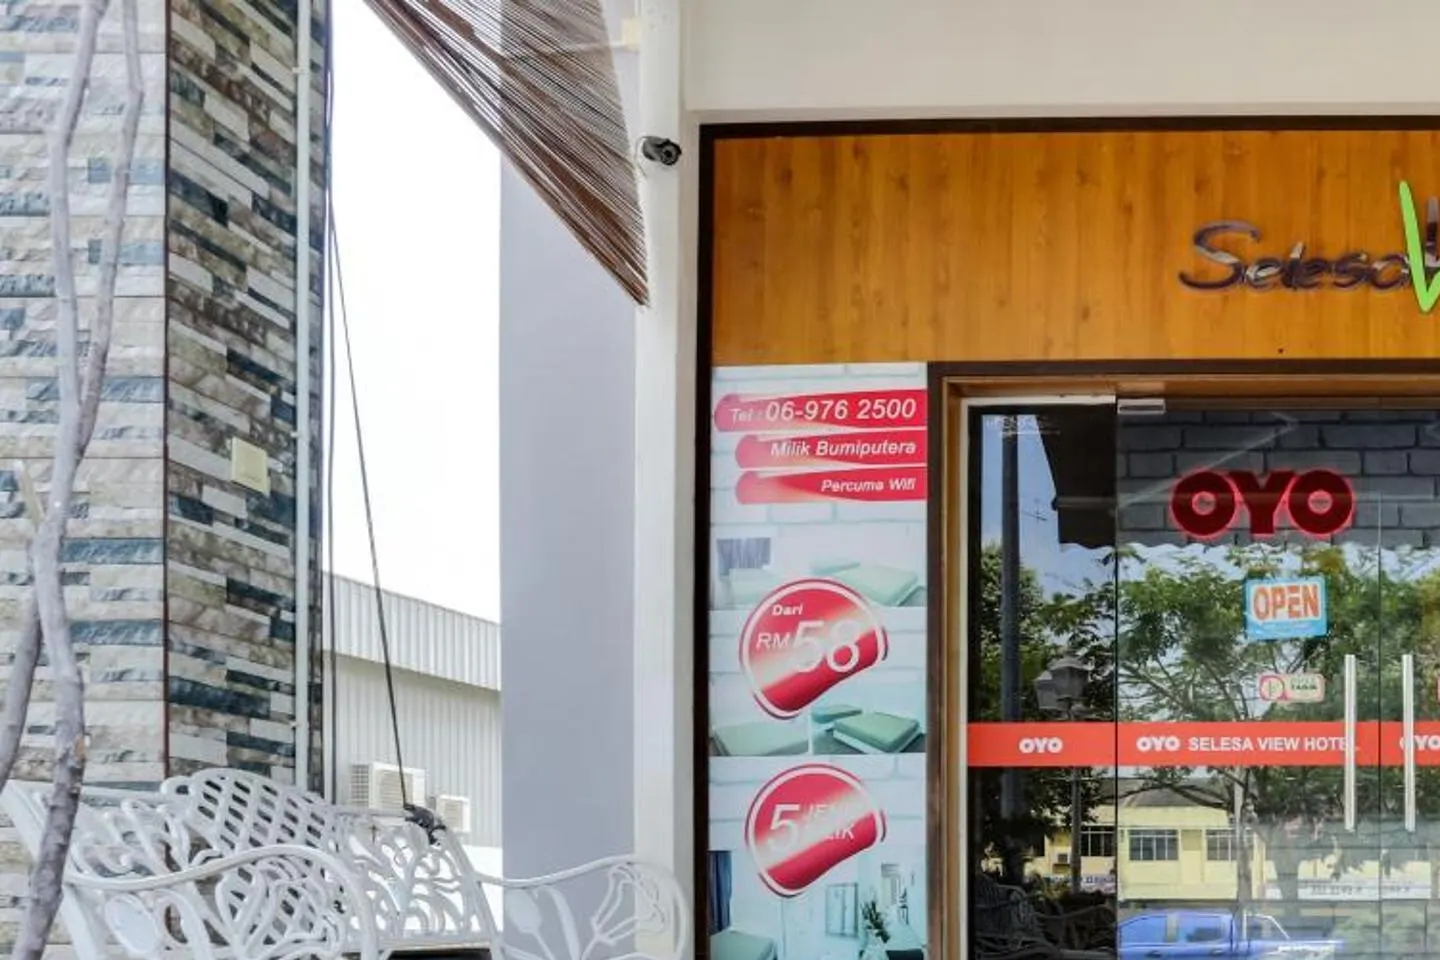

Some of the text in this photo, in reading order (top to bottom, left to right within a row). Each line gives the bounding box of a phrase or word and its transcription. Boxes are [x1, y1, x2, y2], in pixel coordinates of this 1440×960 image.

[765, 400, 849, 421] 06-976
[856, 398, 917, 420] 2500
[771, 440, 916, 458] Milik Bumiputera
[821, 478, 917, 492] Percuma Wifi
[1169, 468, 1357, 540] OYO
[771, 603, 804, 617] Dari
[1253, 583, 1319, 621] OPEN
[1018, 736, 1064, 754] OYO
[1136, 735, 1182, 753] OYO
[1187, 736, 1254, 752] SELESA
[1257, 736, 1301, 752] VIEW
[768, 803, 802, 851] 5
